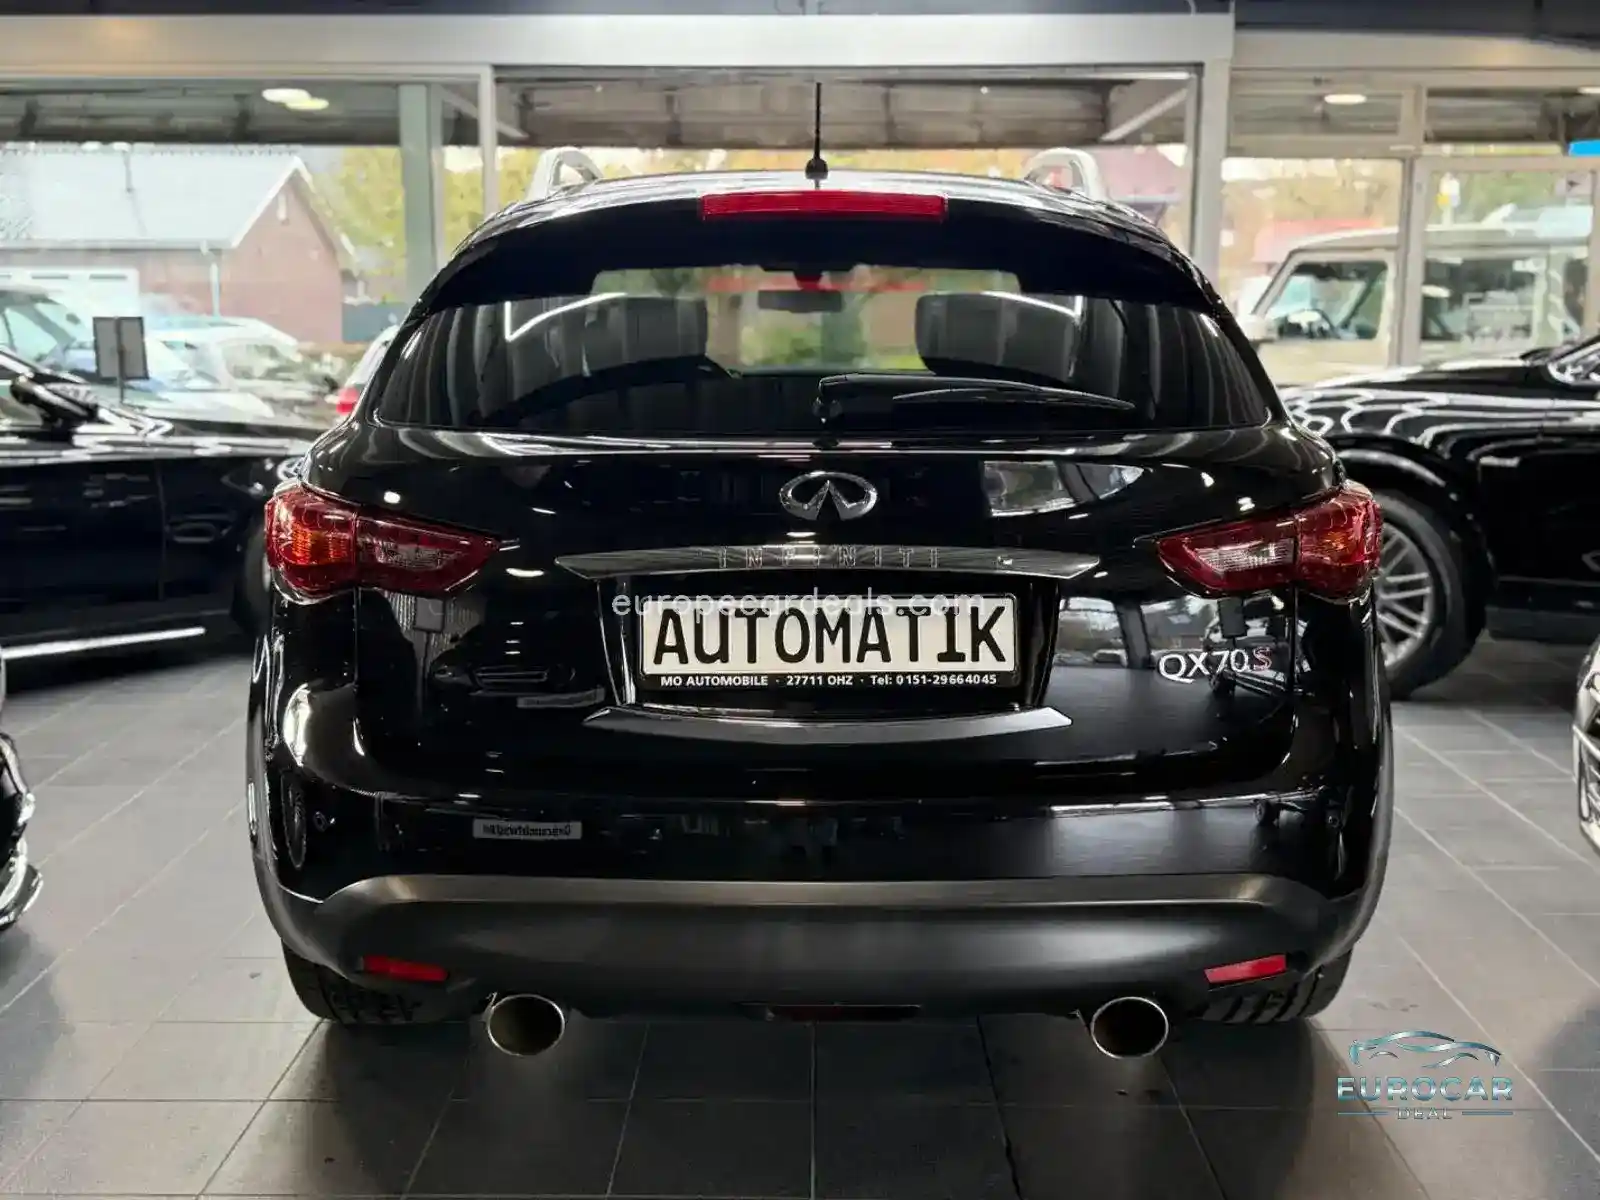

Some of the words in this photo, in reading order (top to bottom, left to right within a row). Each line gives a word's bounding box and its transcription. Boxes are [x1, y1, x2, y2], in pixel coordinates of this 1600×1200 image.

[718, 545, 939, 569] INFINITI
[653, 605, 1007, 665] AUTOMATIK
[660, 675, 683, 687] MO
[686, 675, 768, 687] AUTOMOBILE
[786, 675, 824, 686] 27711
[827, 675, 853, 686] OHZ
[871, 674, 893, 686] Tel:
